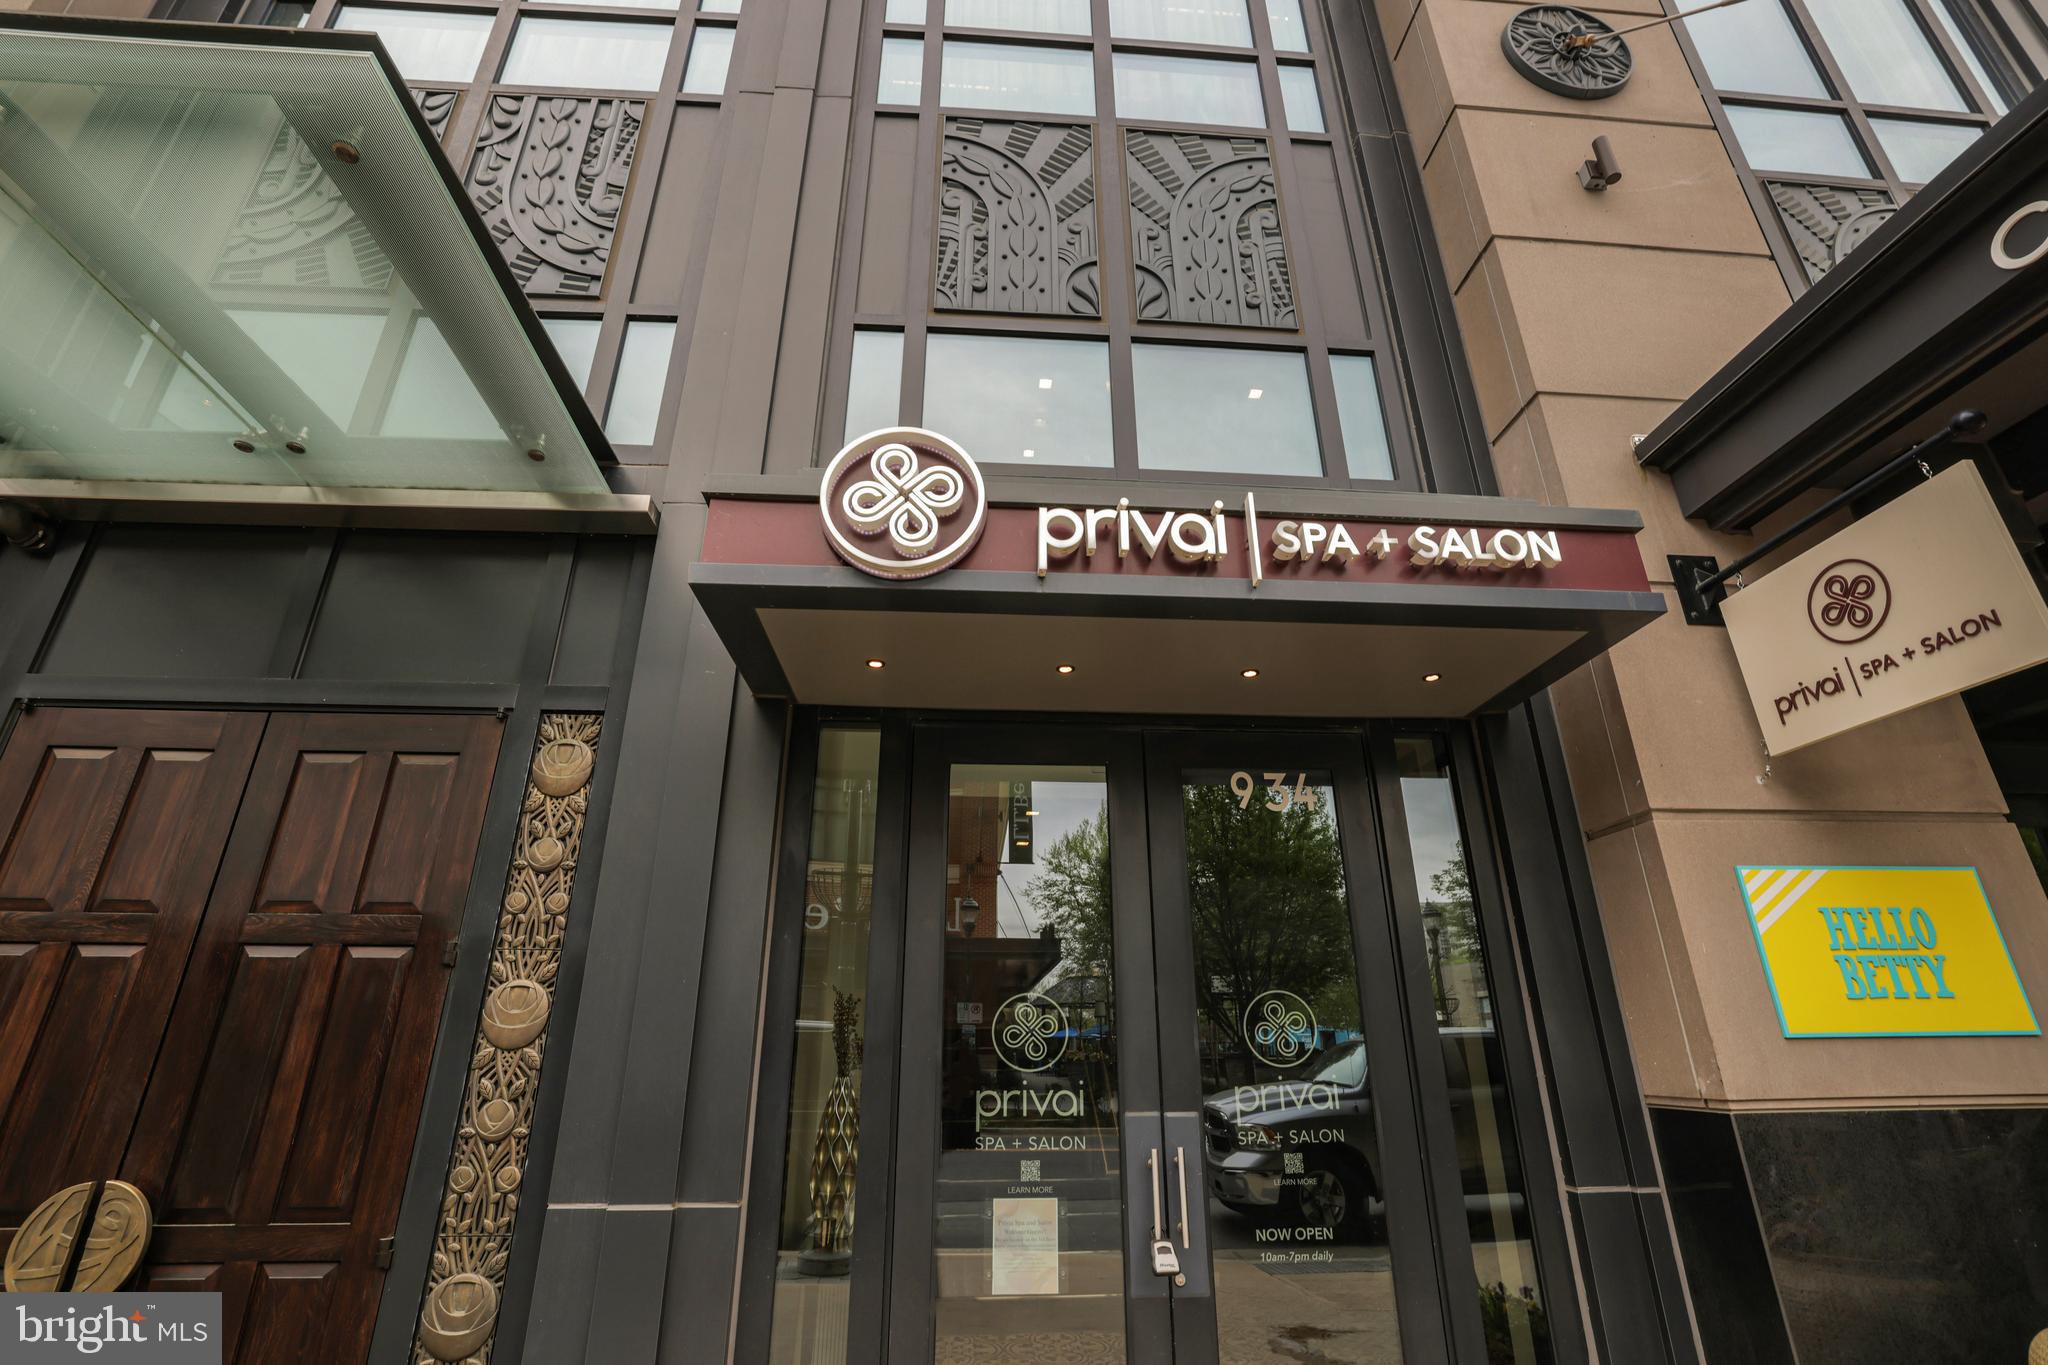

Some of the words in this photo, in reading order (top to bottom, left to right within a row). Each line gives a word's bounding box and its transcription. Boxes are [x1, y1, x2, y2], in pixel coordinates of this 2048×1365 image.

[1037, 497, 1228, 577] privai
[1272, 520, 1361, 561] SPA
[1366, 528, 1399, 561] +
[1408, 525, 1563, 569] SALON
[1774, 666, 1845, 726] privai
[1859, 653, 1900, 680] SPA
[1902, 647, 1916, 661] +
[1920, 608, 2002, 655] SALON
[1230, 771, 1318, 812] 934
[1817, 906, 1937, 951] HELLO
[1833, 954, 1955, 1000] BETTY
[975, 1079, 1085, 1133] privai
[1233, 1074, 1341, 1127] privai
[975, 1136, 1006, 1151] SPA
[1028, 1135, 1086, 1151] SALON
[1238, 1131, 1269, 1146] SPA
[1289, 1128, 1345, 1144] SALON
[1007, 1186, 1031, 1194] LEARN
[1032, 1186, 1054, 1194] MORE
[1297, 1177, 1318, 1185] MORE
[1255, 1228, 1292, 1242] NOW
[1294, 1227, 1334, 1241] OPEN
[1260, 1251, 1310, 1263] 10am-7pm
[1311, 1250, 1334, 1263] daily
